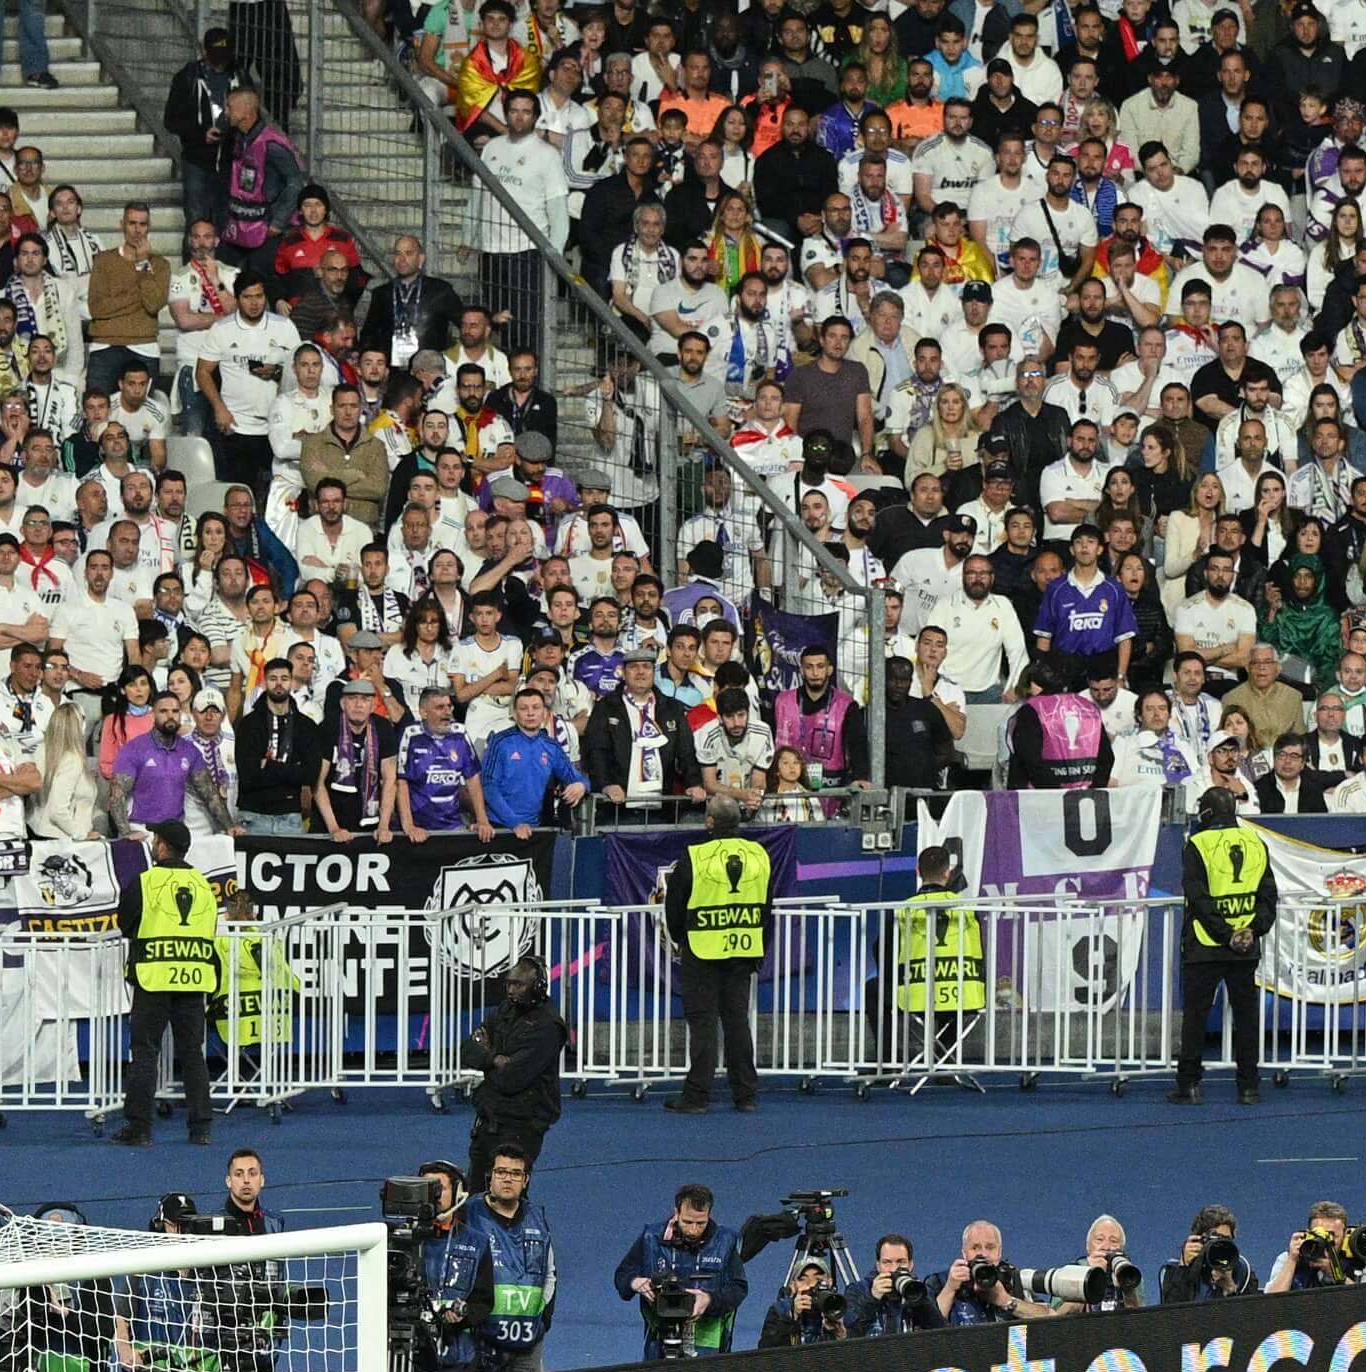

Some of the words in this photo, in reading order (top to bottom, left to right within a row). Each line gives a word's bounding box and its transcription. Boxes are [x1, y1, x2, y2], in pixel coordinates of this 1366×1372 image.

[237, 852, 392, 894] ICTOR
[168, 966, 203, 985] 260
[501, 1289, 533, 1312] TV
[497, 1320, 534, 1343] 303
